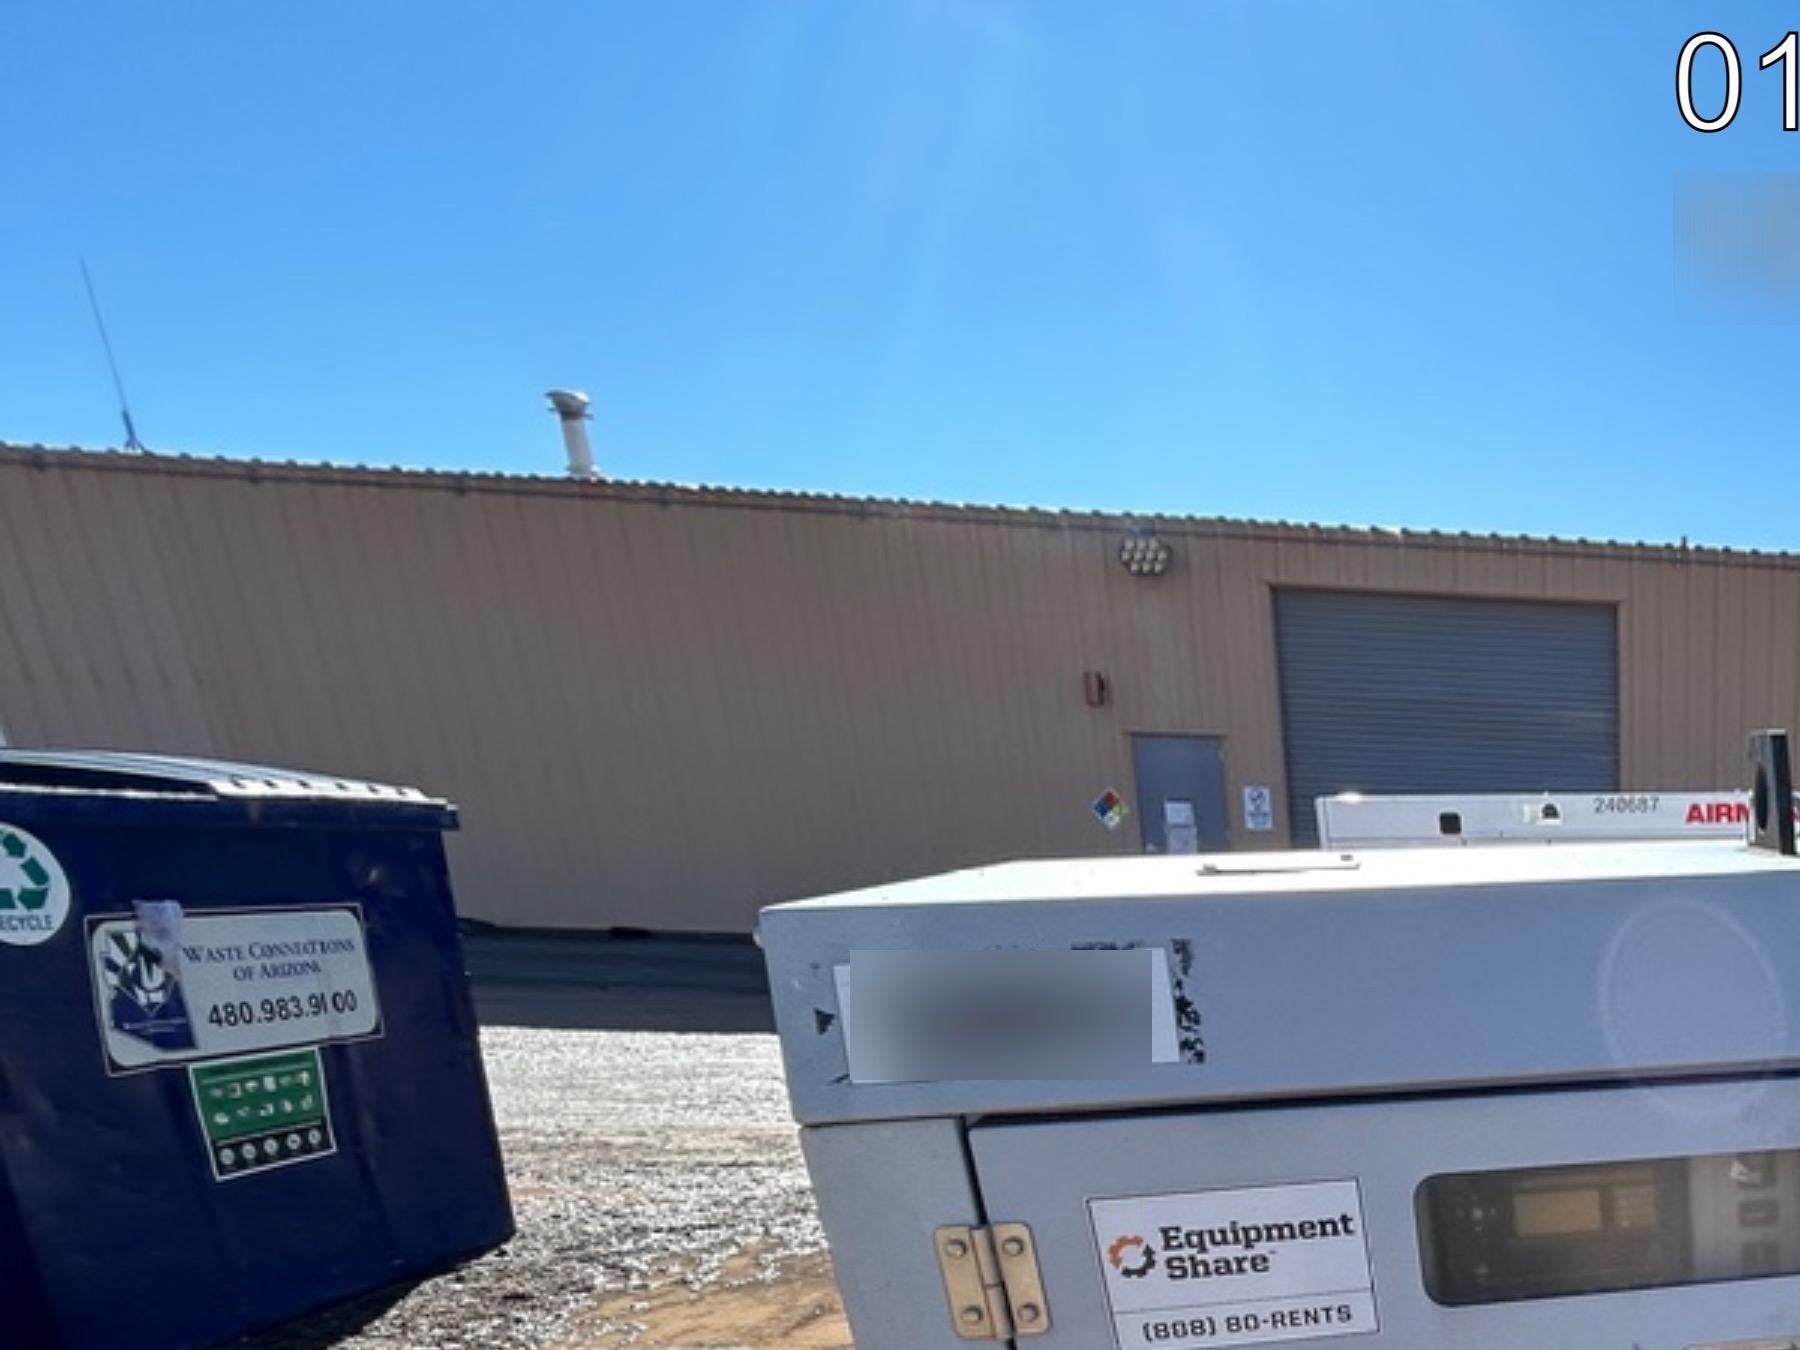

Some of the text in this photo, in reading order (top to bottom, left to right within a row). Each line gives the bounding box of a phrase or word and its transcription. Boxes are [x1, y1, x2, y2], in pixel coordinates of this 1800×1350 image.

[182, 939, 355, 963] WASTE CONNECTIONS
[232, 966, 254, 981] OF
[208, 990, 358, 1027] 480.983.9100
[1158, 1213, 1355, 1254] Equipment
[1165, 1254, 1270, 1280] Share
